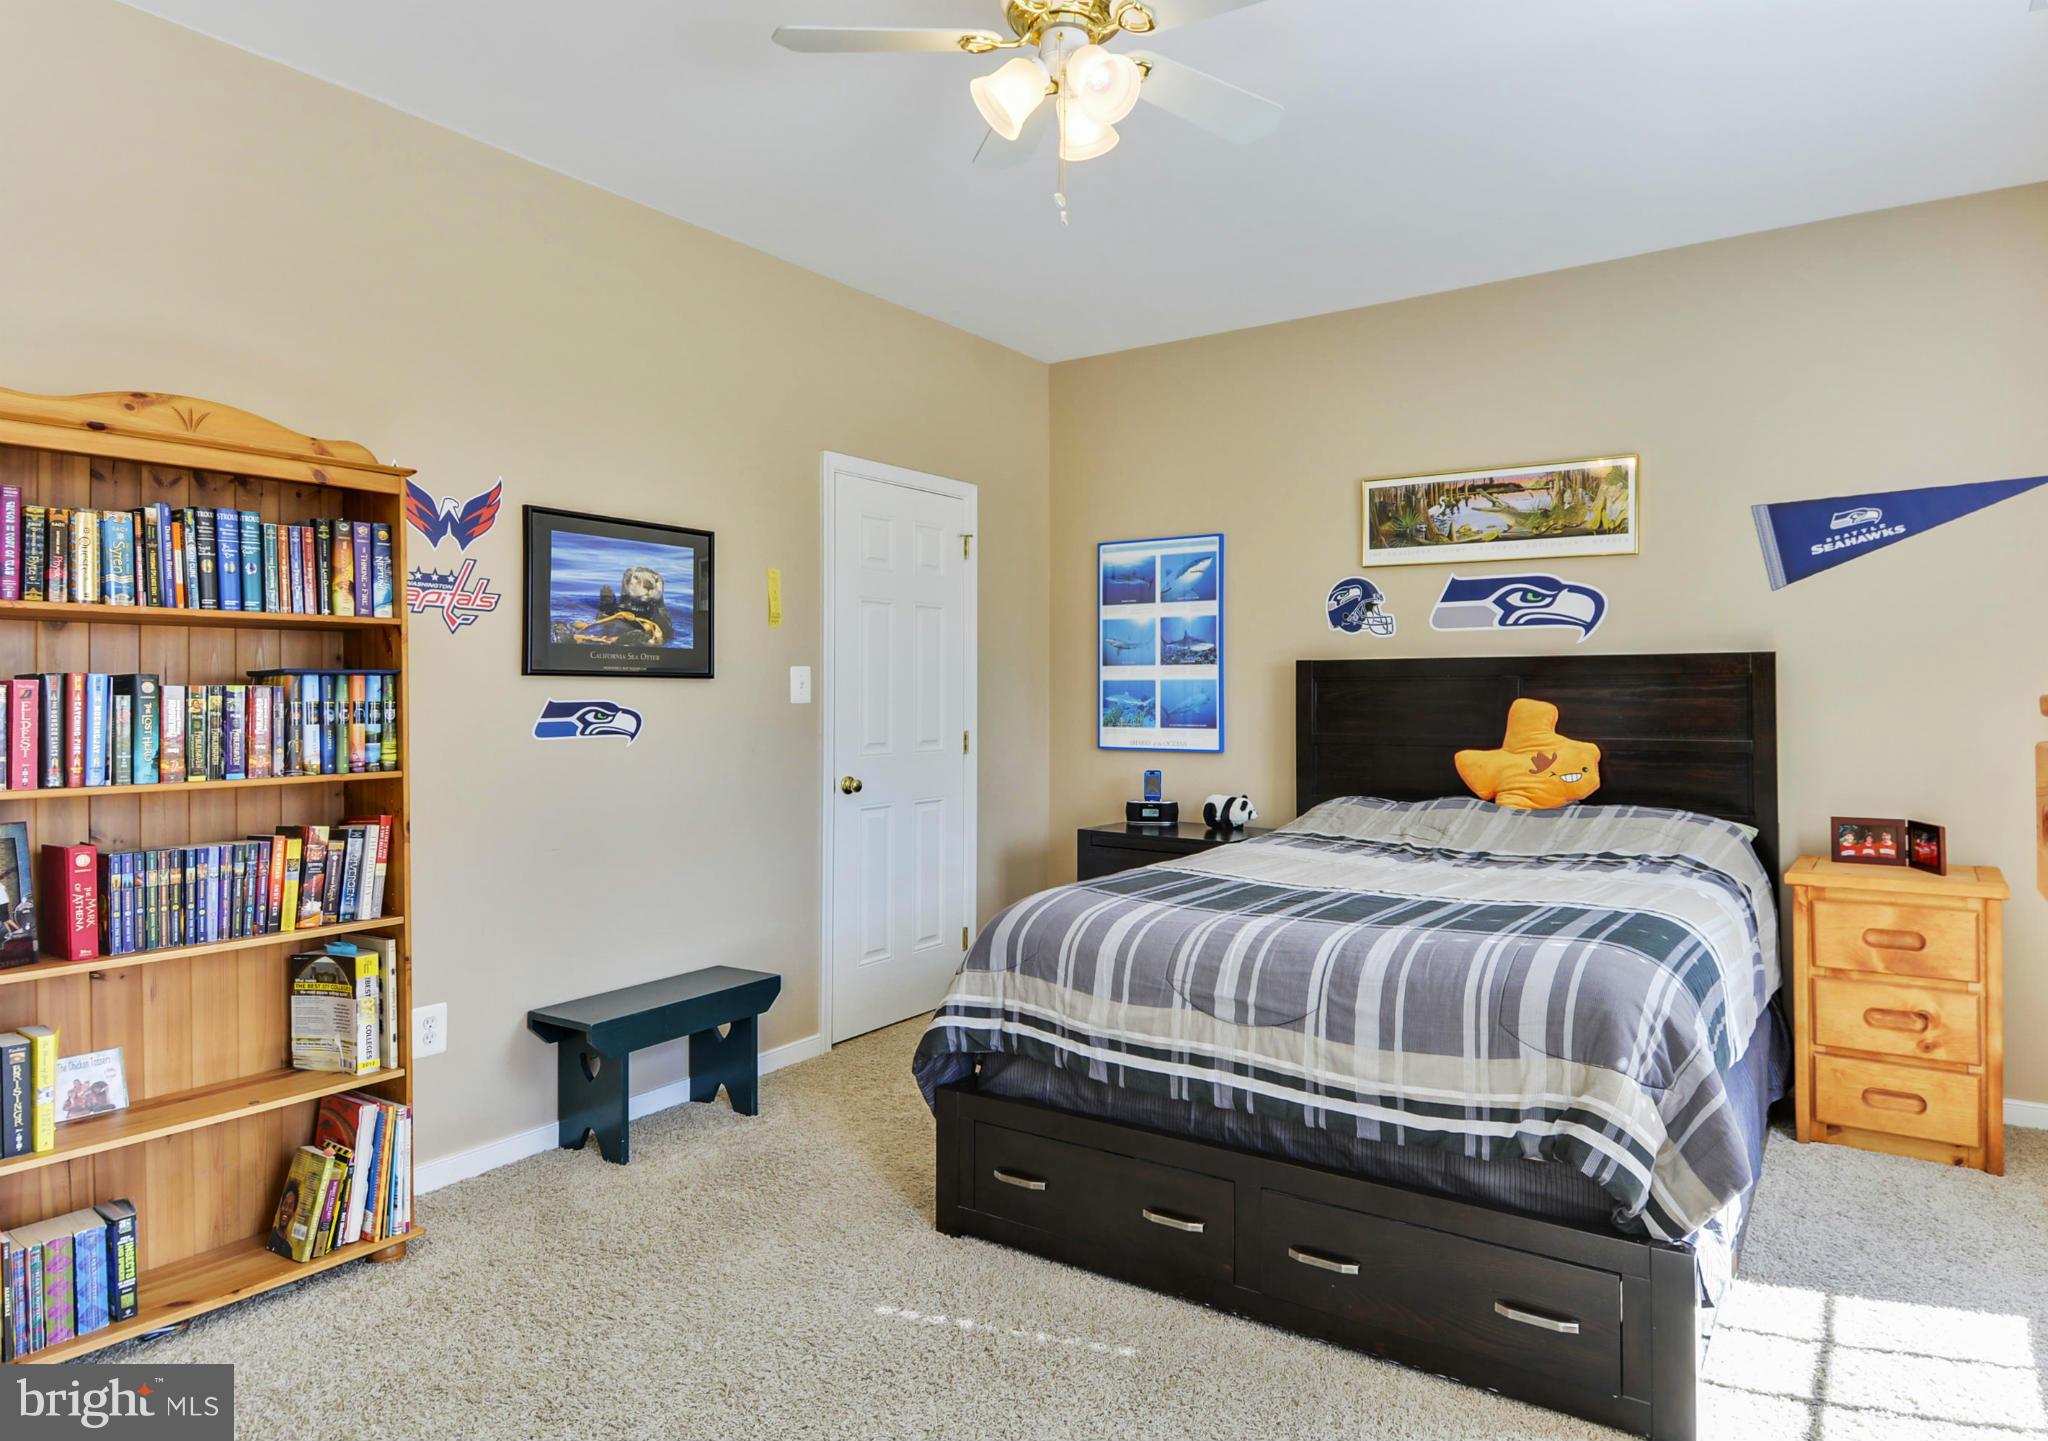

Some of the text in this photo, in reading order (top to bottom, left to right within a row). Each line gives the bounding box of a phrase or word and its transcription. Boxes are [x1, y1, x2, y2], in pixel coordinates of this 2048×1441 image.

[1810, 524, 1906, 555] SEAHAWKS
[1826, 523, 1886, 543] SEATTLE
[109, 541, 126, 574] Syren
[19, 701, 33, 758] ELDEST
[73, 701, 82, 755] CATCHING FIRE
[141, 714, 153, 734] LOST
[142, 736, 153, 762] HERO
[346, 854, 358, 906] DIVERGENT
[72, 893, 84, 932] ATHENA
[86, 898, 97, 928] MARK
[365, 1024, 373, 1061] COLLEGES
[124, 1241, 136, 1279] INSECTS
